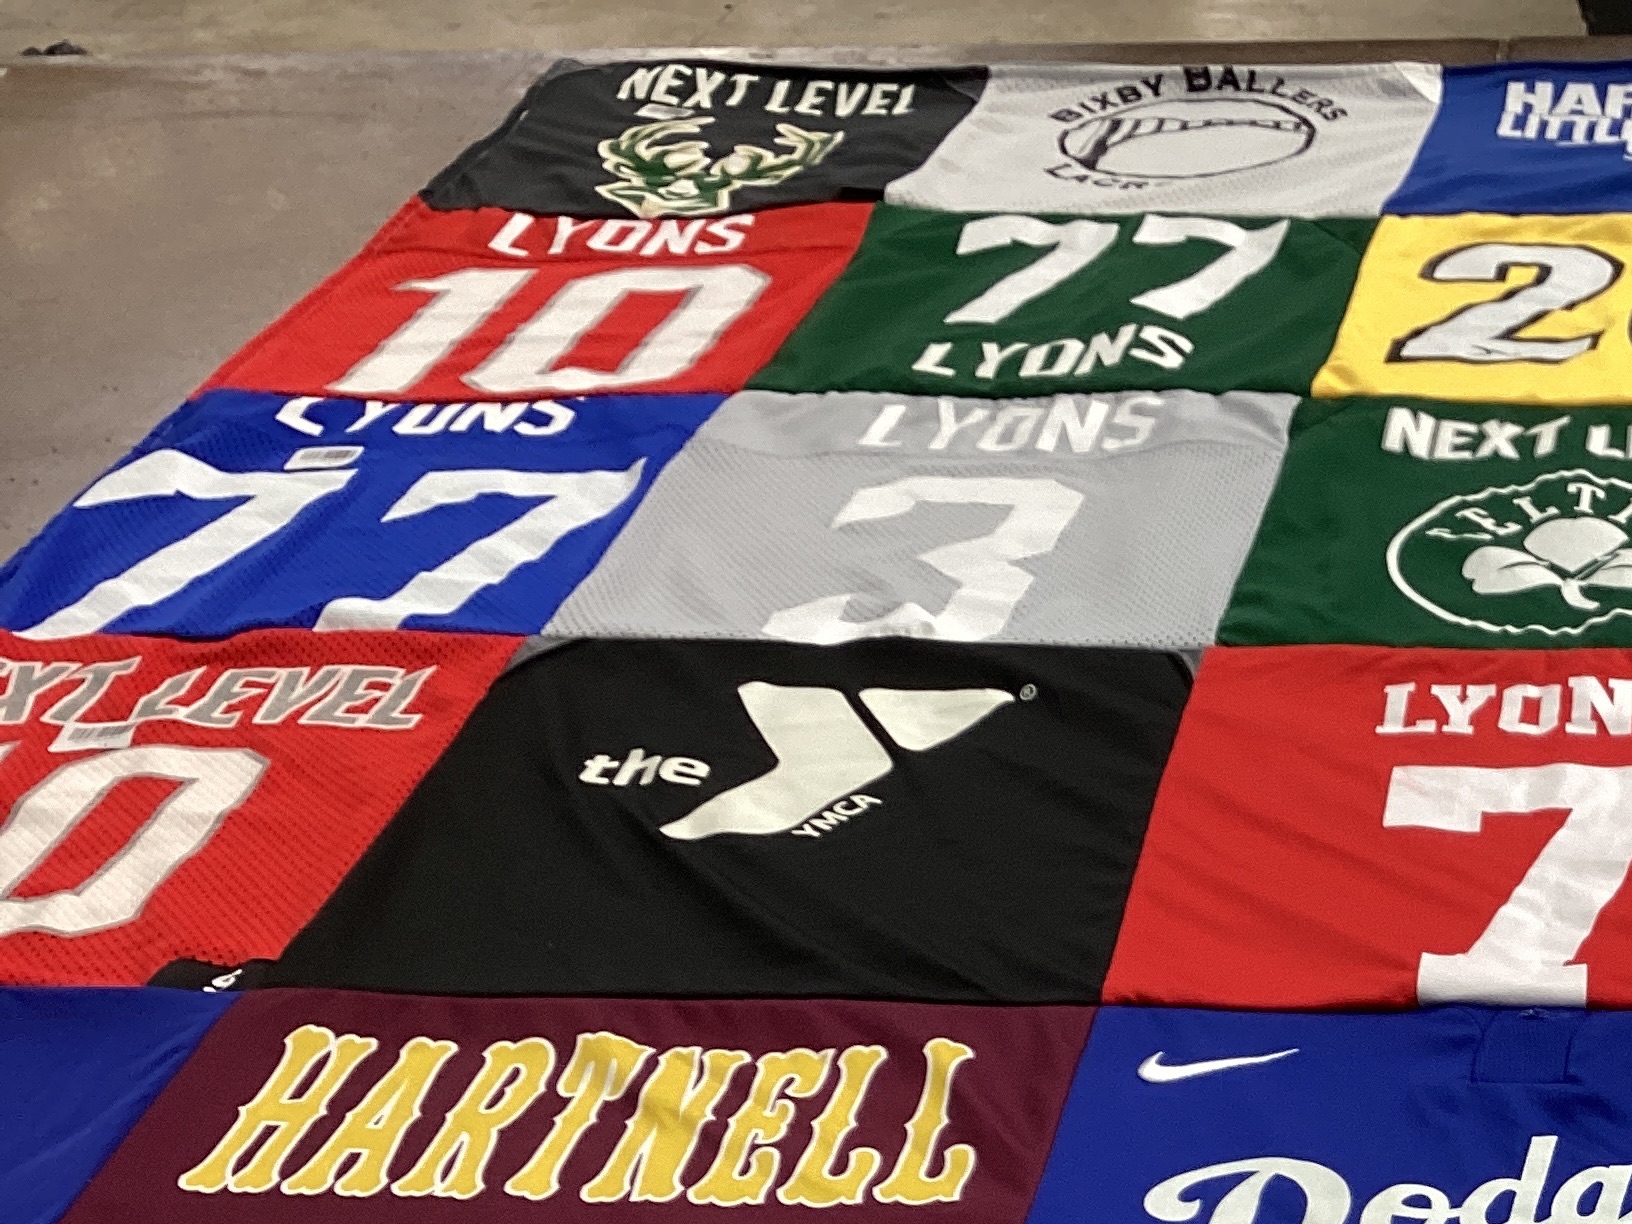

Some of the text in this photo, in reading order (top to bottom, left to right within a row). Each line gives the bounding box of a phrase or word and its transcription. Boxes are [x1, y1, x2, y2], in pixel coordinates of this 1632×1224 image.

[616, 64, 916, 117] NEXT LEVEL
[1183, 64, 1348, 122] BALLERS
[488, 213, 755, 256] LYONS
[944, 214, 1291, 324] 77
[324, 262, 773, 394] 10
[911, 323, 1195, 379] LYONS
[274, 395, 577, 437] LYONS
[857, 395, 1164, 452] LYONS
[1381, 406, 1572, 461] NEXT
[12, 448, 647, 639] 77
[761, 475, 1086, 646] 3
[126, 664, 438, 729] LEVEL
[578, 746, 711, 786] the
[0, 740, 271, 938] 0
[790, 791, 883, 839] YMCA
[178, 1023, 976, 1208] HARTNELL
